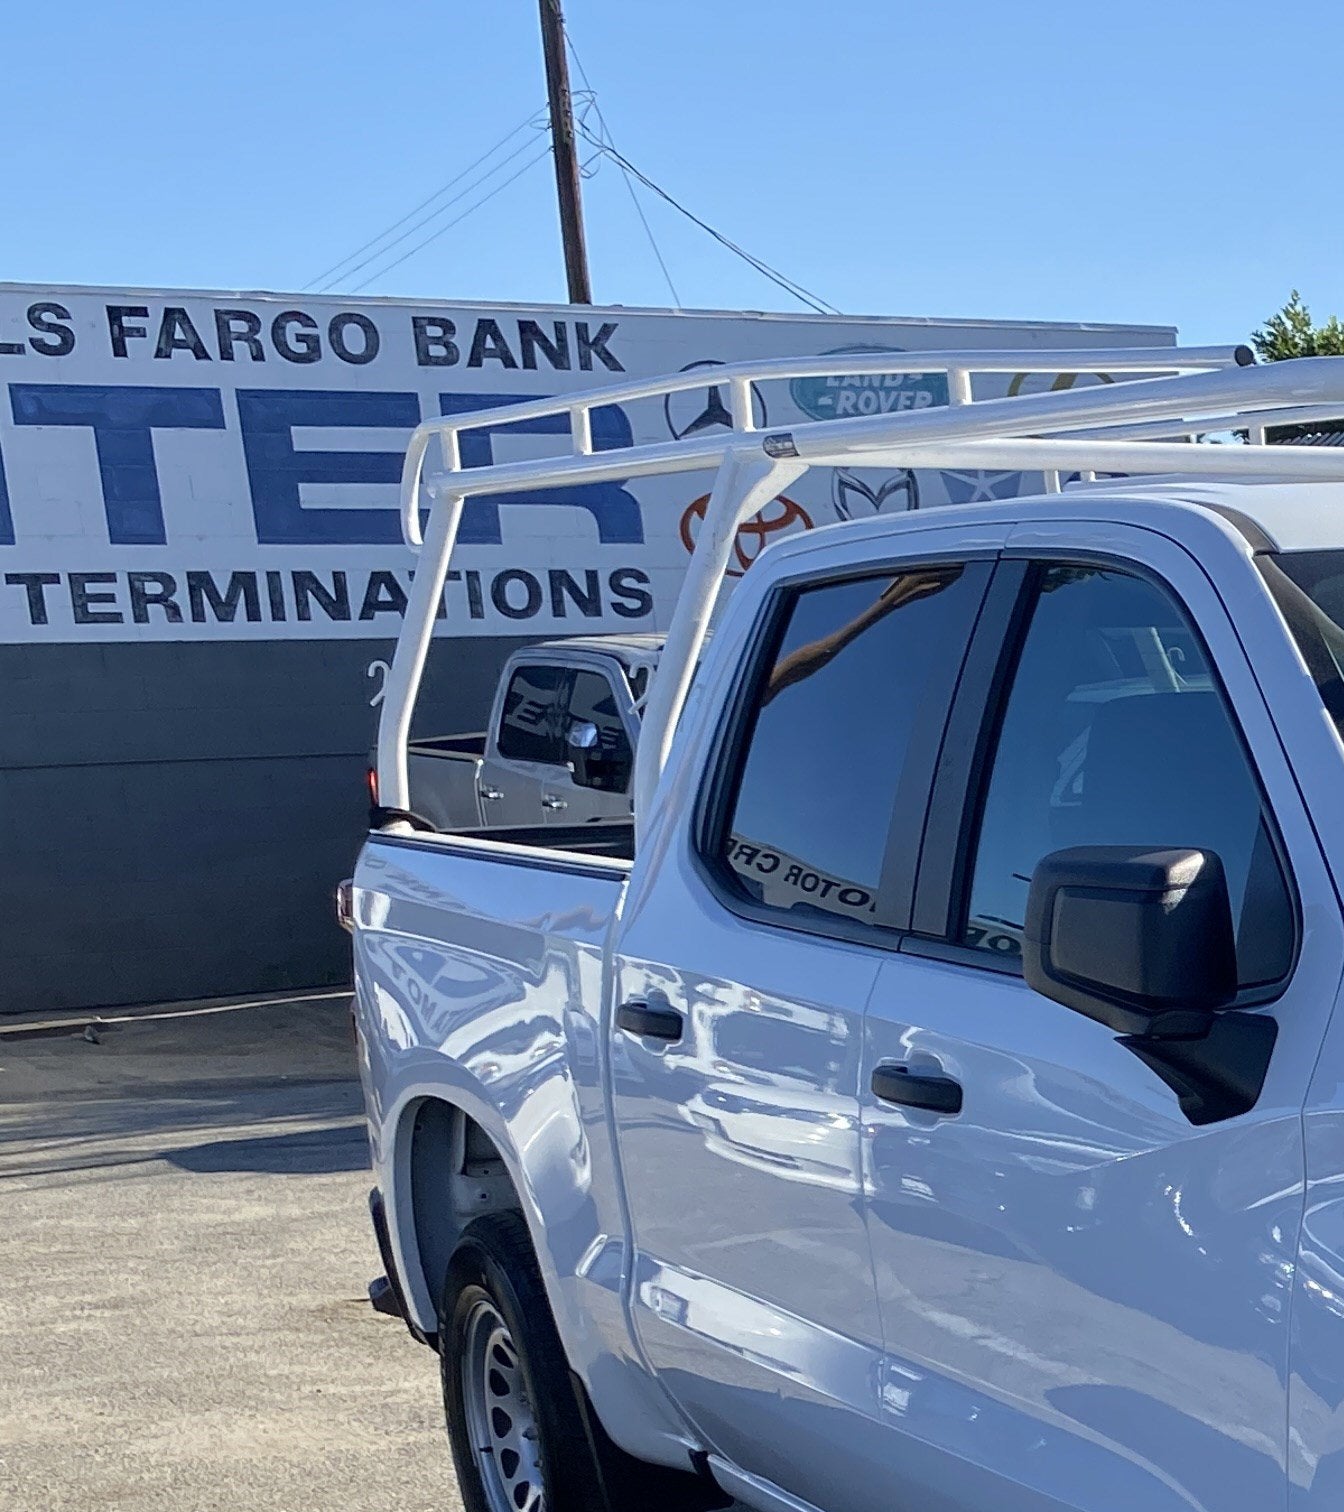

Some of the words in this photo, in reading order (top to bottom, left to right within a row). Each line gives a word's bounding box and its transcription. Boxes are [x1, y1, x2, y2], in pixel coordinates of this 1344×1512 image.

[105, 304, 380, 365] FARGO
[411, 315, 625, 371] BANK
[836, 390, 933, 415] ROVER
[0, 383, 645, 545] TER
